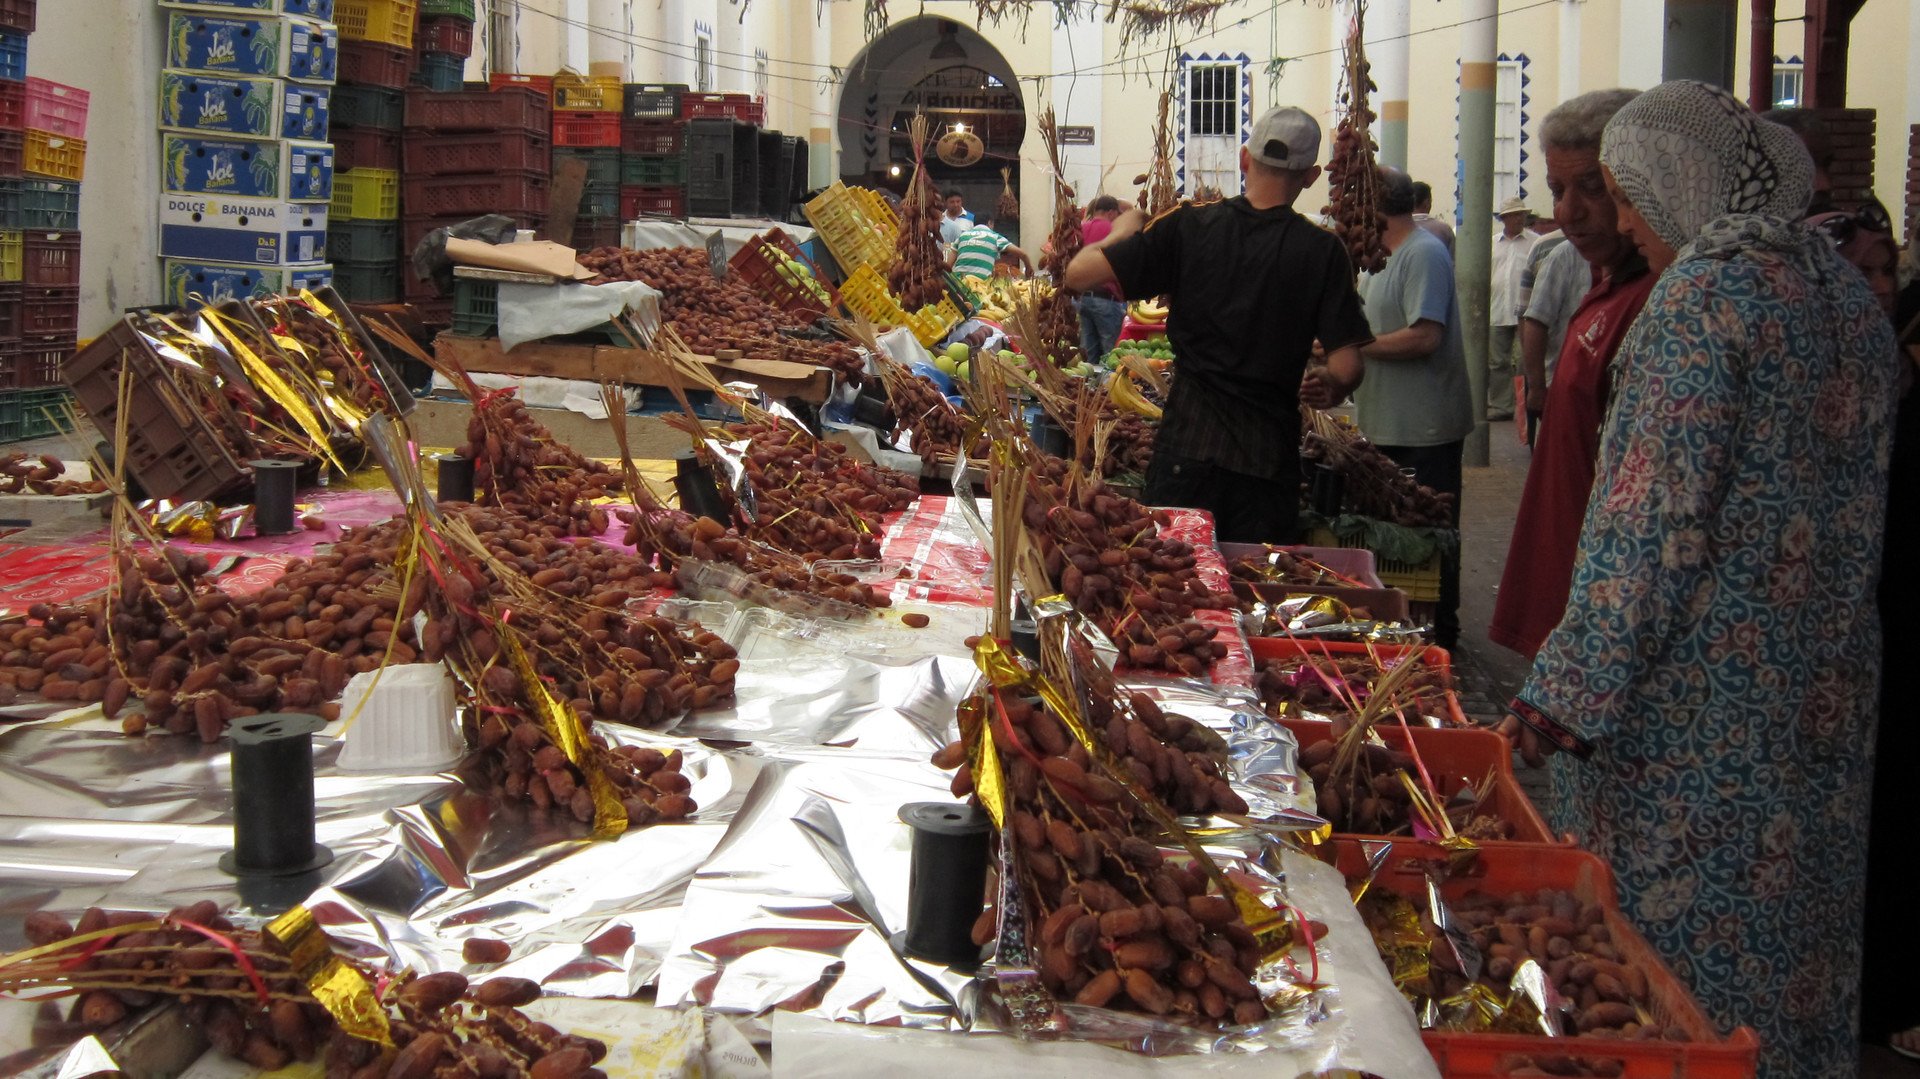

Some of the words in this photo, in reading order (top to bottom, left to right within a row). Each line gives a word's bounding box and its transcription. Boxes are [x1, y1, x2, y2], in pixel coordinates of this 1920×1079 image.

[207, 31, 235, 57] Joe
[206, 55, 236, 65] Banana
[200, 91, 227, 117] Joe
[199, 114, 228, 124] Banana
[207, 154, 235, 181] Joe
[205, 178, 235, 188] Banana
[168, 201, 206, 213] DOLCE
[207, 201, 218, 215] &
[222, 204, 276, 218] BANANA
[258, 237, 276, 247] D&B
